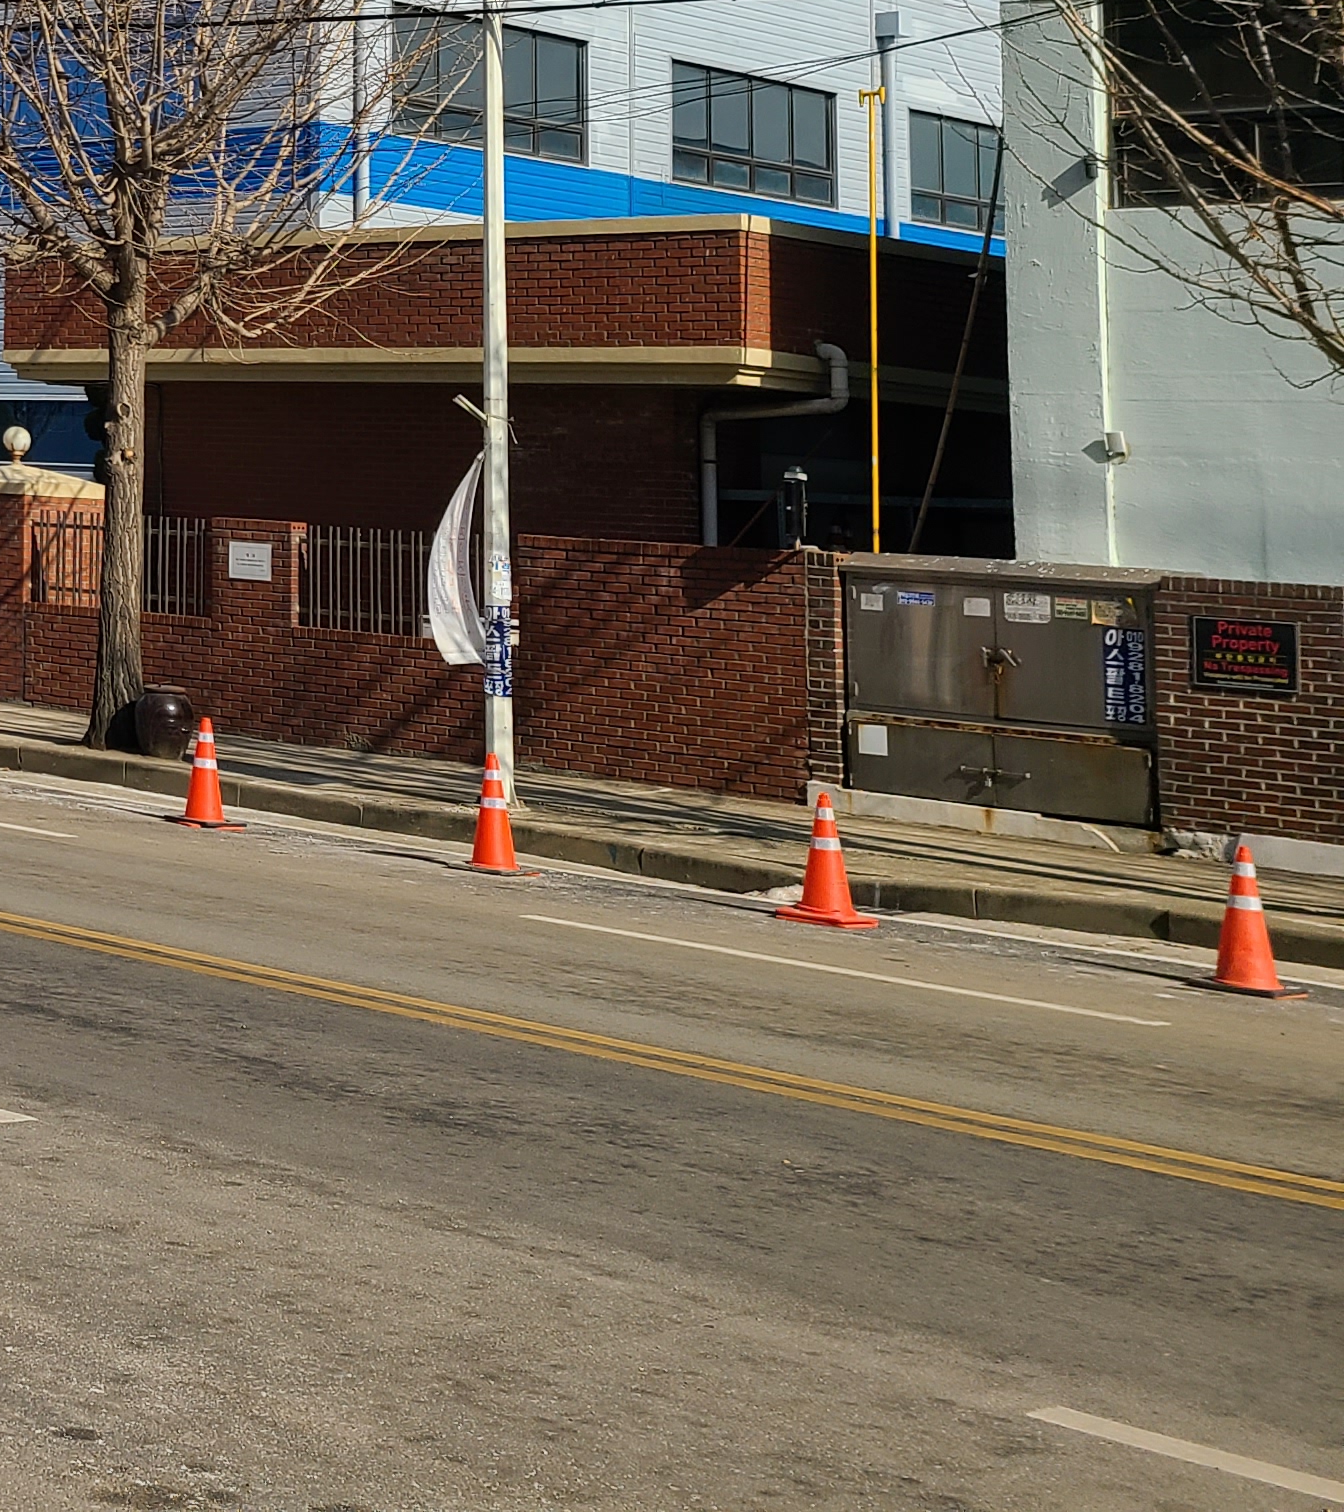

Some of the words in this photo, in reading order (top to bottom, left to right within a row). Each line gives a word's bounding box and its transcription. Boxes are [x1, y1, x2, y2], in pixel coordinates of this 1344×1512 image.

[1217, 621, 1273, 637] Private
[1211, 635, 1280, 654] Property
[1203, 661, 1218, 670] No
